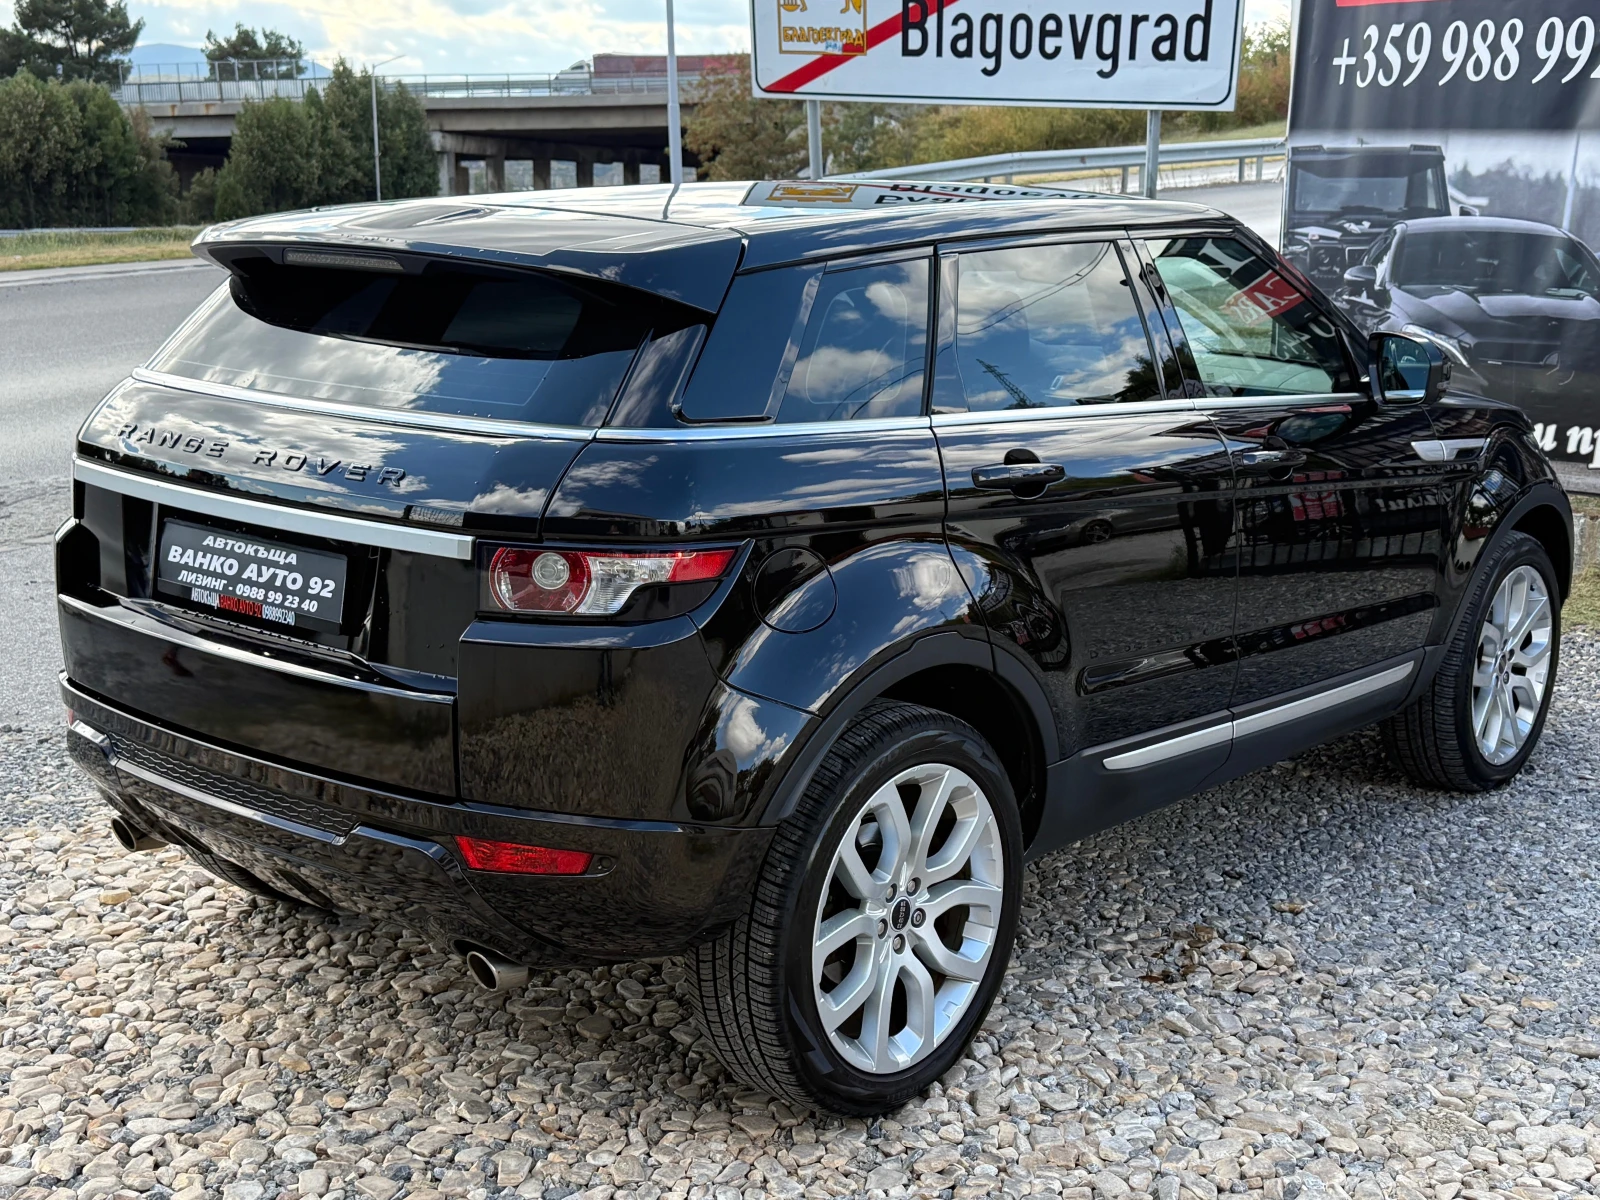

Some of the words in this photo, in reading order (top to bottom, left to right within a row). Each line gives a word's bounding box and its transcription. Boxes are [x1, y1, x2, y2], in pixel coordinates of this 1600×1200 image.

[901, 0, 1210, 78] Blagoevgrad
[1332, 23, 1432, 88] +359
[1439, 18, 1524, 86] 988
[116, 422, 229, 457] RANGE
[252, 449, 406, 488] ROVER
[167, 545, 239, 576] ВАНКО
[241, 563, 303, 590] АУТО
[308, 576, 336, 598] 92
[202, 535, 297, 566] АВТОКЪЩА
[178, 570, 228, 591] ЛИЗИНГ
[235, 583, 265, 600] 0988
[267, 591, 283, 604] 99
[284, 595, 300, 609] 23
[301, 600, 318, 613] 40
